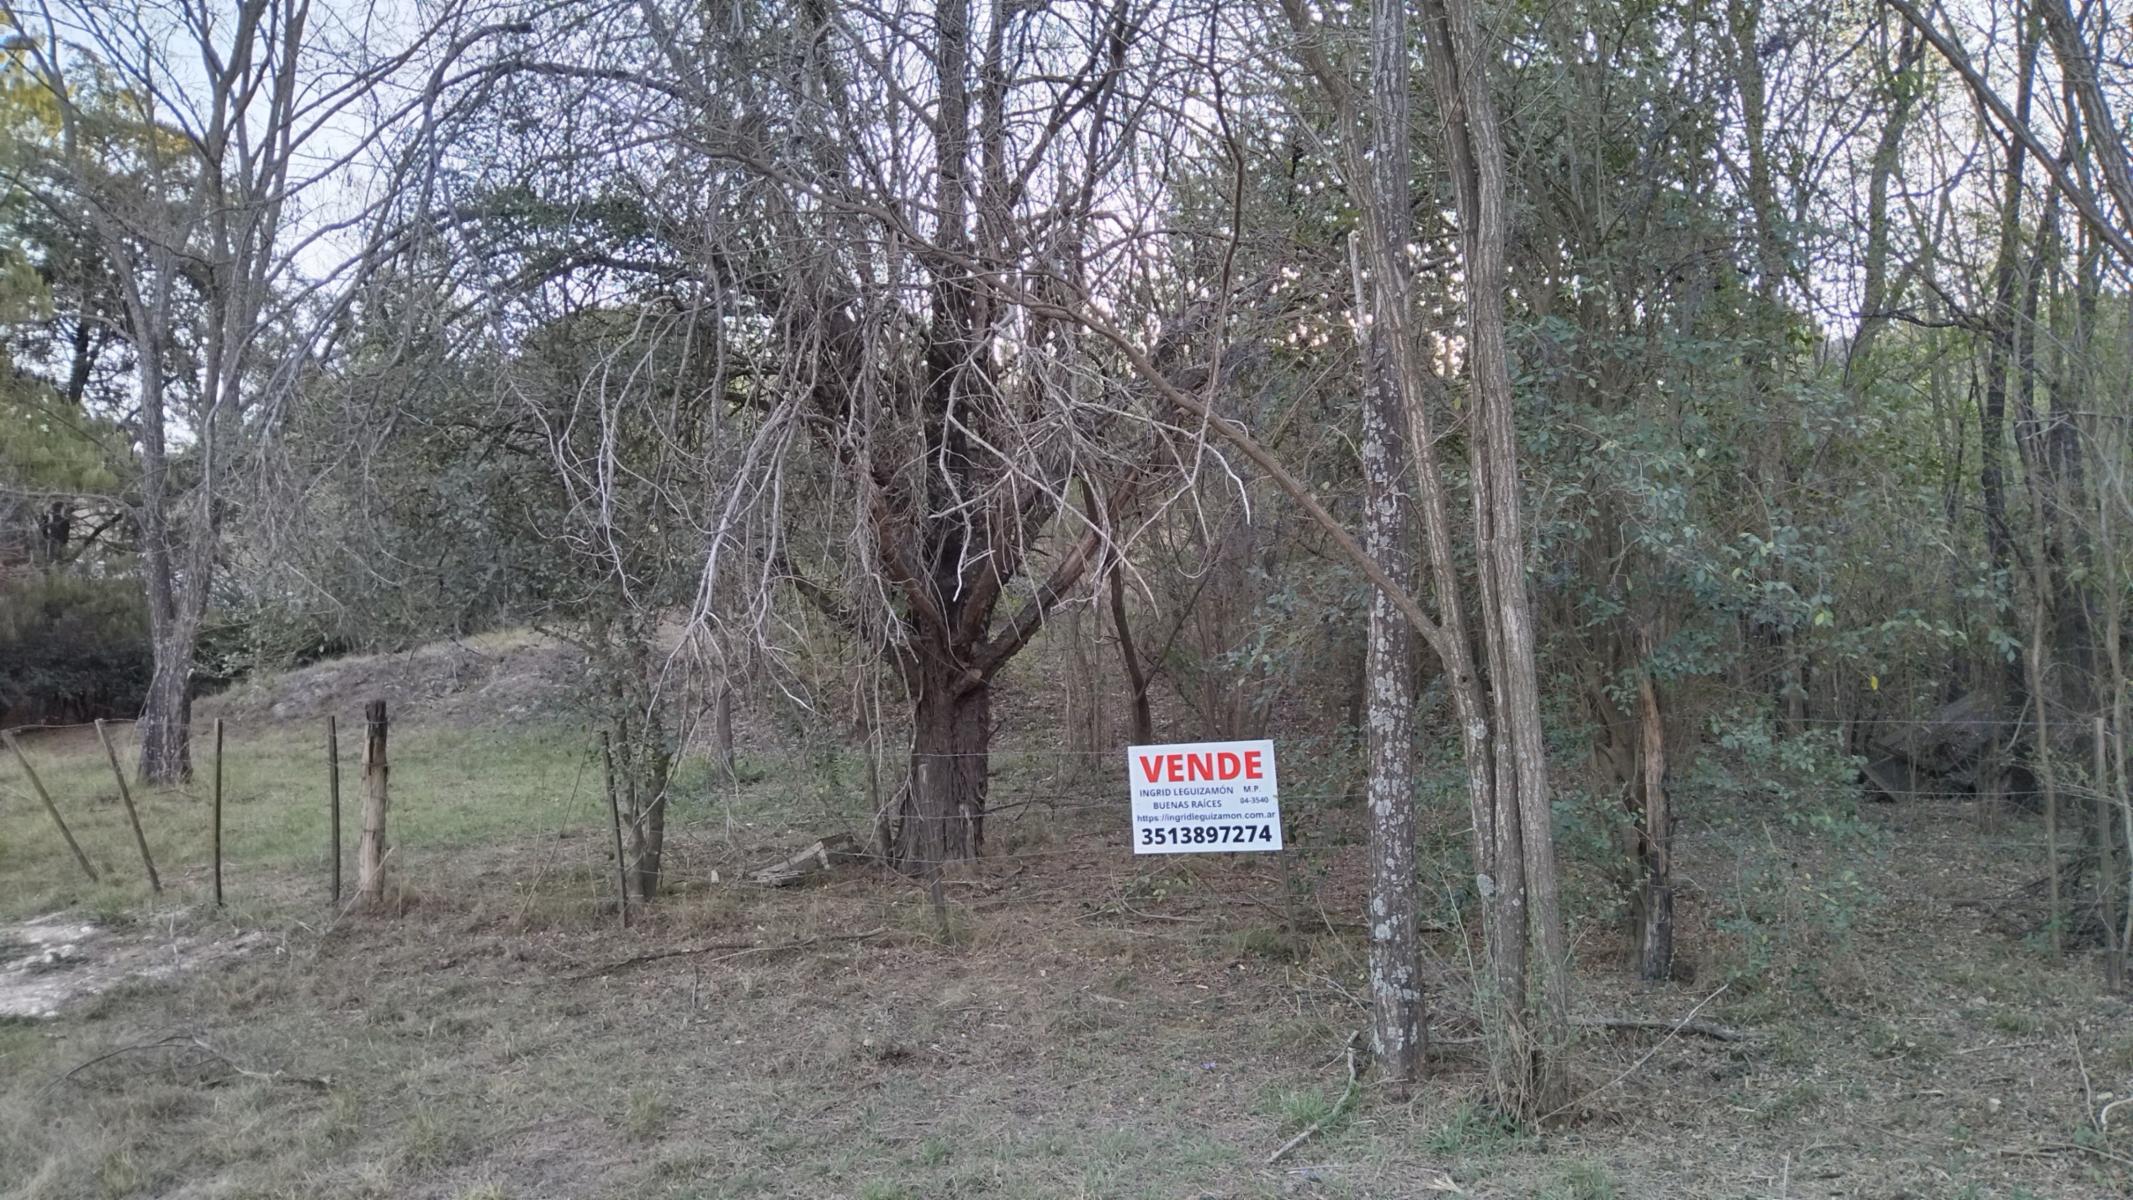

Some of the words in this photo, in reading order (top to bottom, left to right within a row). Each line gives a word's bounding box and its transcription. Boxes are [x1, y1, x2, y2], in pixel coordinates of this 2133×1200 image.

[1139, 751, 1263, 783] VENDE
[1139, 788, 1171, 797] INGRID
[1173, 786, 1234, 797] LEGUIZAMÓN
[1243, 785, 1261, 793] M.P.
[1153, 801, 1189, 809] BUENAS
[1191, 799, 1222, 808] RAÍCES
[1137, 811, 1275, 823] https://ingridleguizamon.com.ar
[1141, 825, 1272, 845] 3513897274
